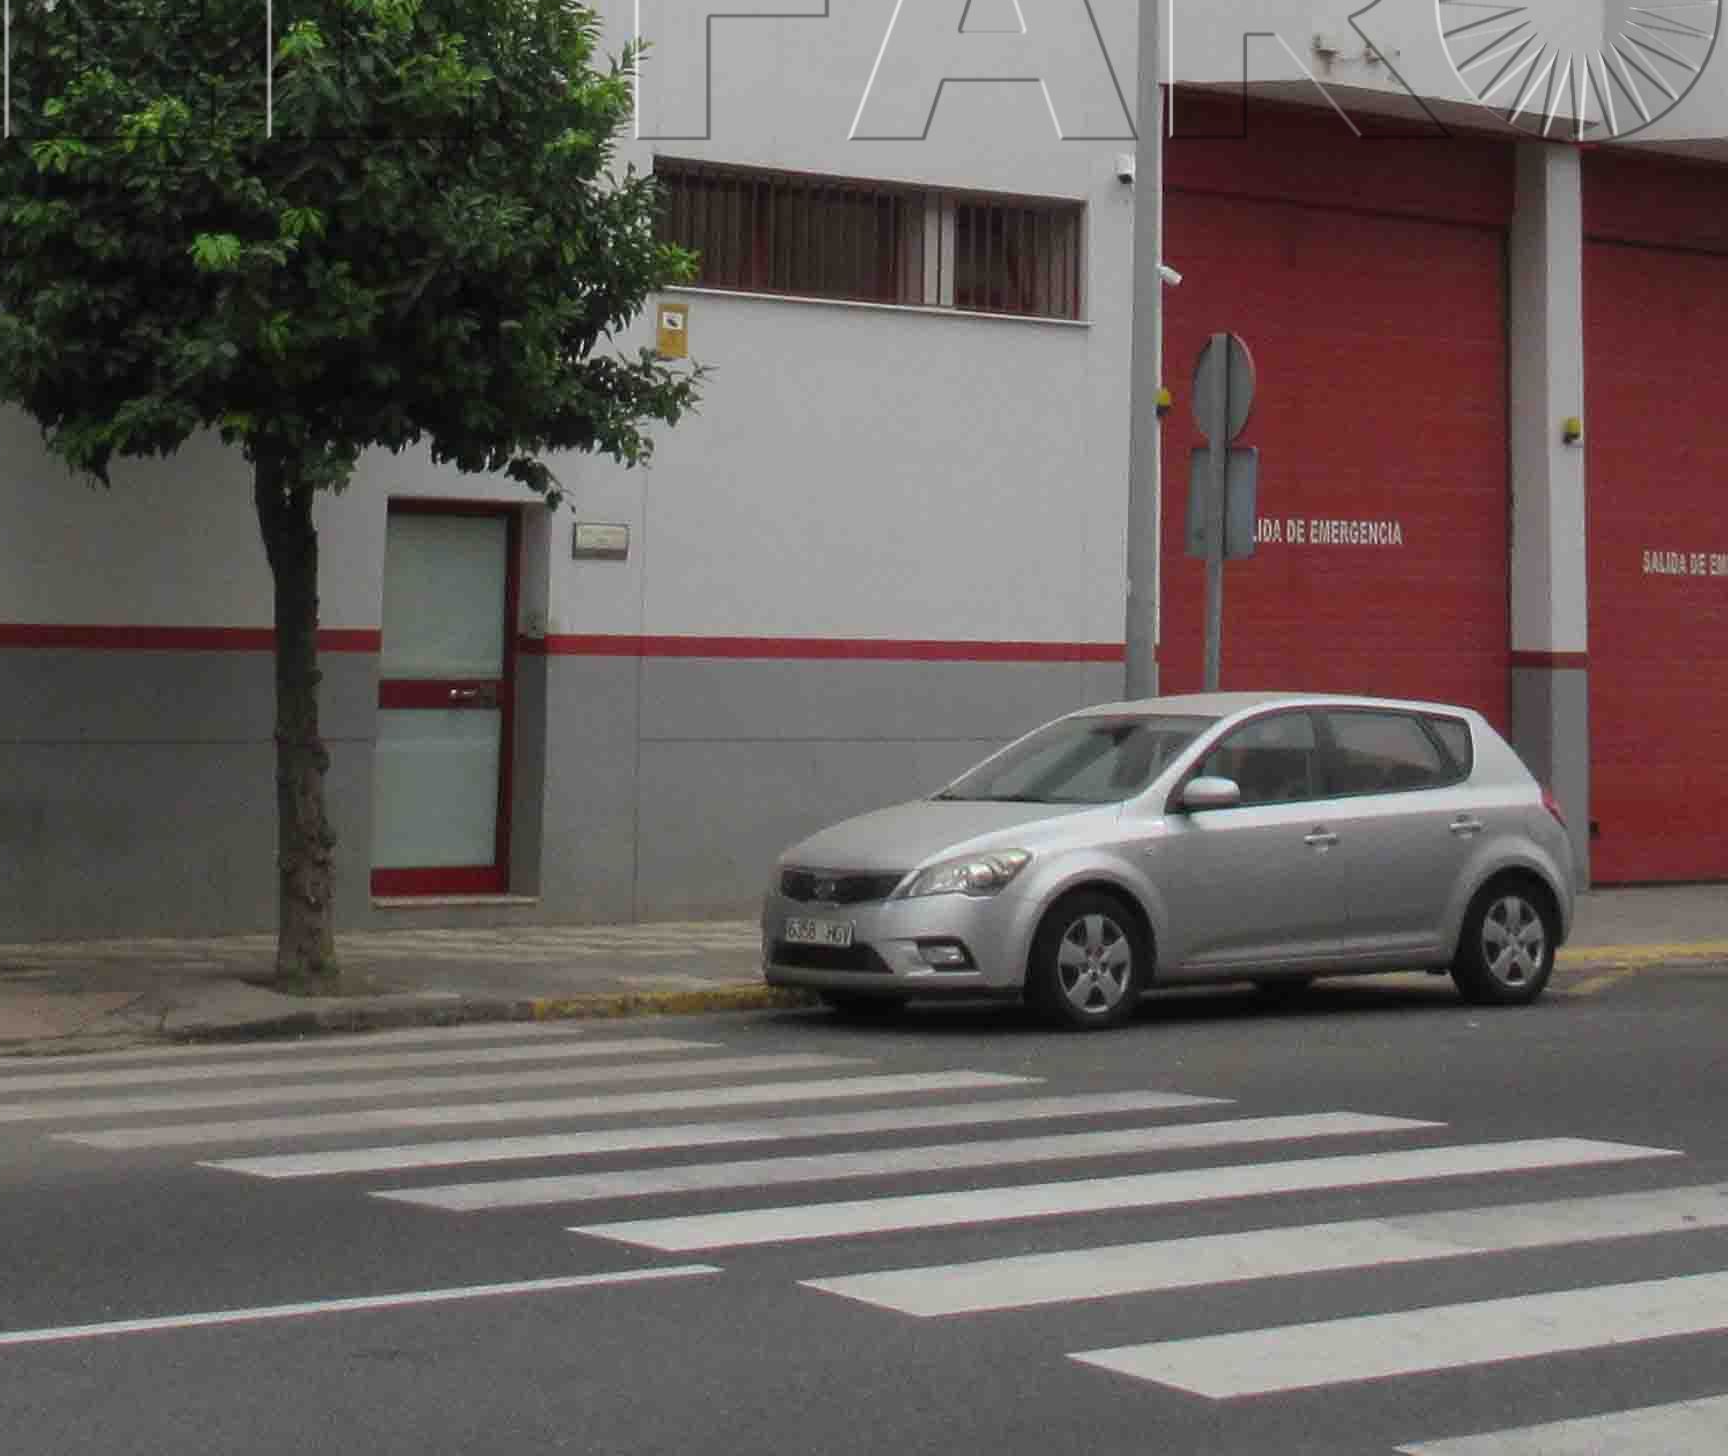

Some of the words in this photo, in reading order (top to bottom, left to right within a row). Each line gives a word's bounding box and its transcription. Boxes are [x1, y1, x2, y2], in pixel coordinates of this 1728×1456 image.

[1286, 519, 1307, 544] DE
[1310, 519, 1404, 545] EMERGENCIA
[1642, 550, 1688, 574] SALIDA
[1690, 552, 1707, 576] DE
